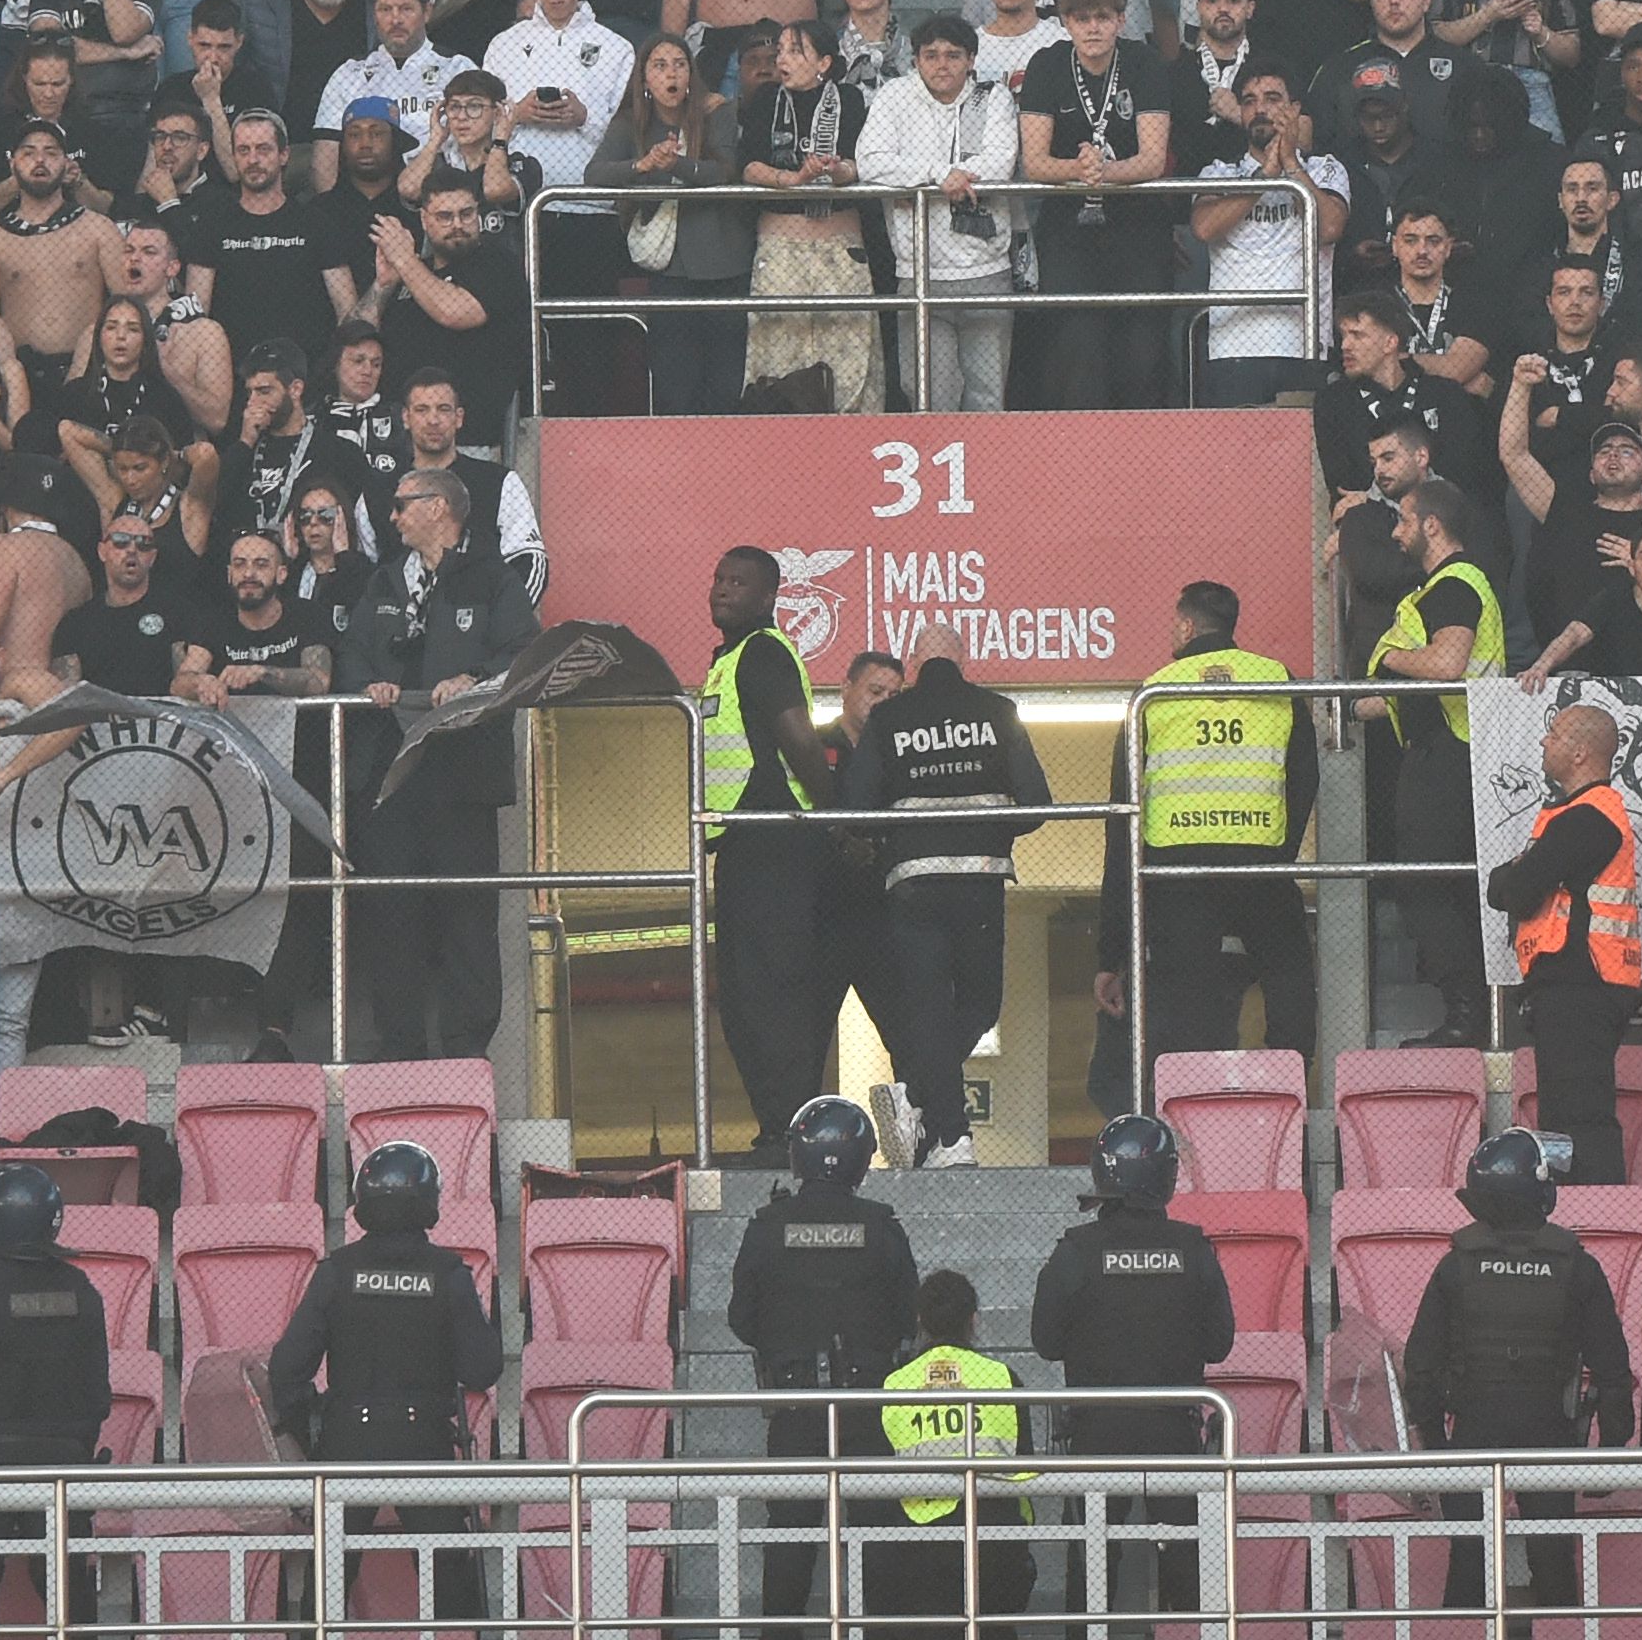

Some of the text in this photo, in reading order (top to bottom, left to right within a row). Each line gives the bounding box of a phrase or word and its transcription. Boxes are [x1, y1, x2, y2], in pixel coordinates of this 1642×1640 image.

[871, 439, 977, 517] 31
[883, 549, 987, 604] MAIS
[64, 712, 227, 772] WHITE
[893, 719, 998, 757] POLÍCIA
[1195, 718, 1246, 747] 336
[909, 760, 984, 780] SPOTTERS
[73, 800, 213, 872] WA
[1168, 810, 1273, 830] ASSISTENTE
